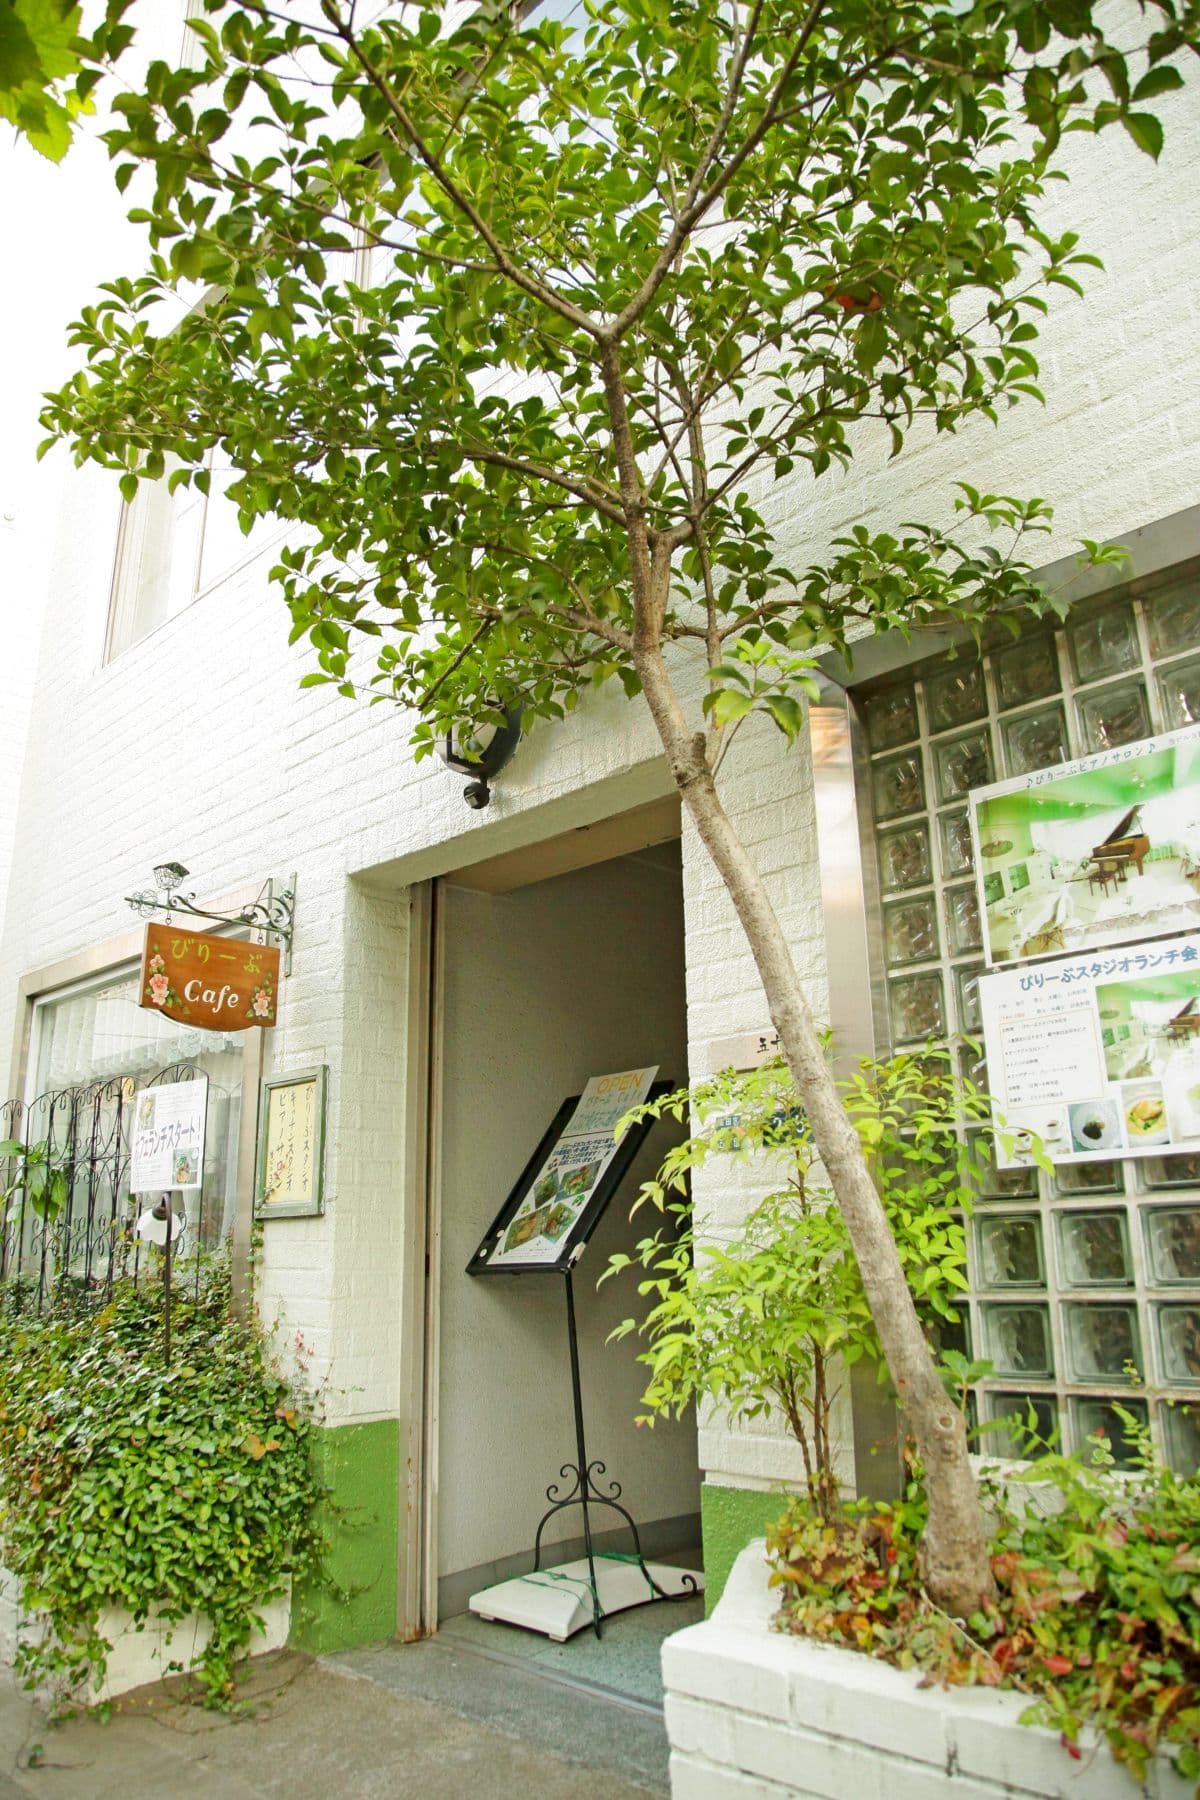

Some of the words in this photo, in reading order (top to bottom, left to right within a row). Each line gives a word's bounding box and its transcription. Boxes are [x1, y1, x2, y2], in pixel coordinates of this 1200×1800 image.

[1036, 747, 1143, 786] びりーぶピアノサロン
[170, 938, 263, 974] びりーぶ
[1019, 945, 1198, 992] びりーぶスタジオランチ会
[184, 979, 240, 1014] Cafe
[597, 1072, 645, 1094] OPEN
